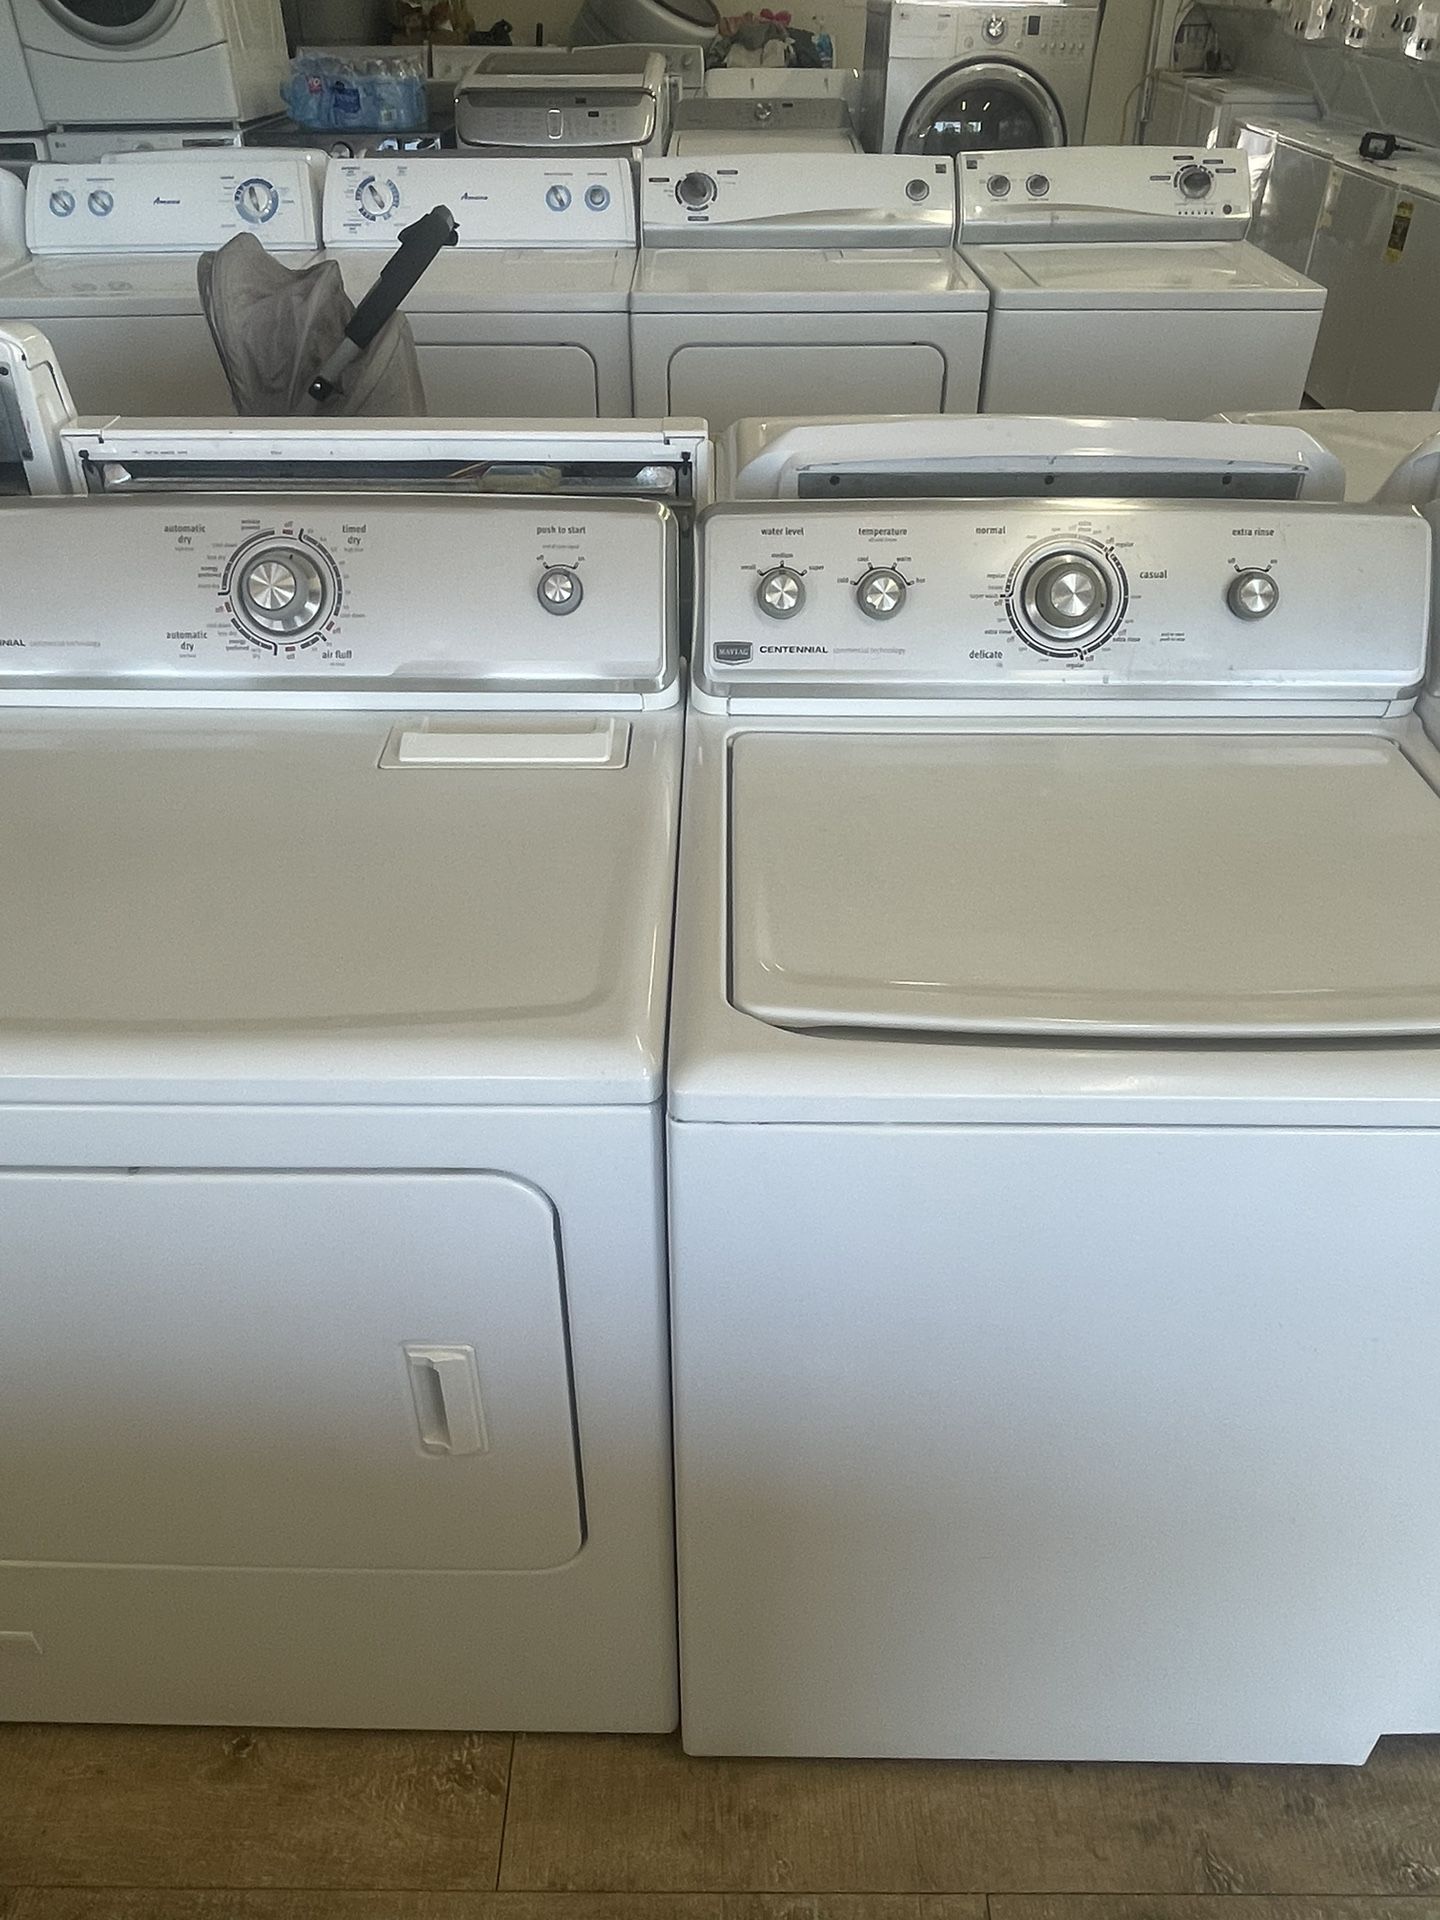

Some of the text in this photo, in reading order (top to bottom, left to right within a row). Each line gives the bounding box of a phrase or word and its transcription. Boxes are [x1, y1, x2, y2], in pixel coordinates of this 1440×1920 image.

[164, 524, 206, 533] automatic
[342, 524, 367, 533] timed
[537, 526, 586, 535] push to start
[761, 526, 805, 536] water level
[858, 527, 908, 537] temperature
[975, 526, 1006, 534] normal
[1232, 528, 1275, 537] extra rinse
[178, 535, 192, 545] dry
[347, 536, 361, 546] dry
[1139, 569, 1168, 579] casual
[166, 631, 208, 639] automatic
[0, 639, 26, 647] NIAL
[181, 641, 194, 652] dry
[719, 648, 749, 656] MAYTAG
[759, 645, 829, 654] CENTENNIAL
[968, 649, 1004, 659] delicate
[322, 650, 353, 659] air fluff
